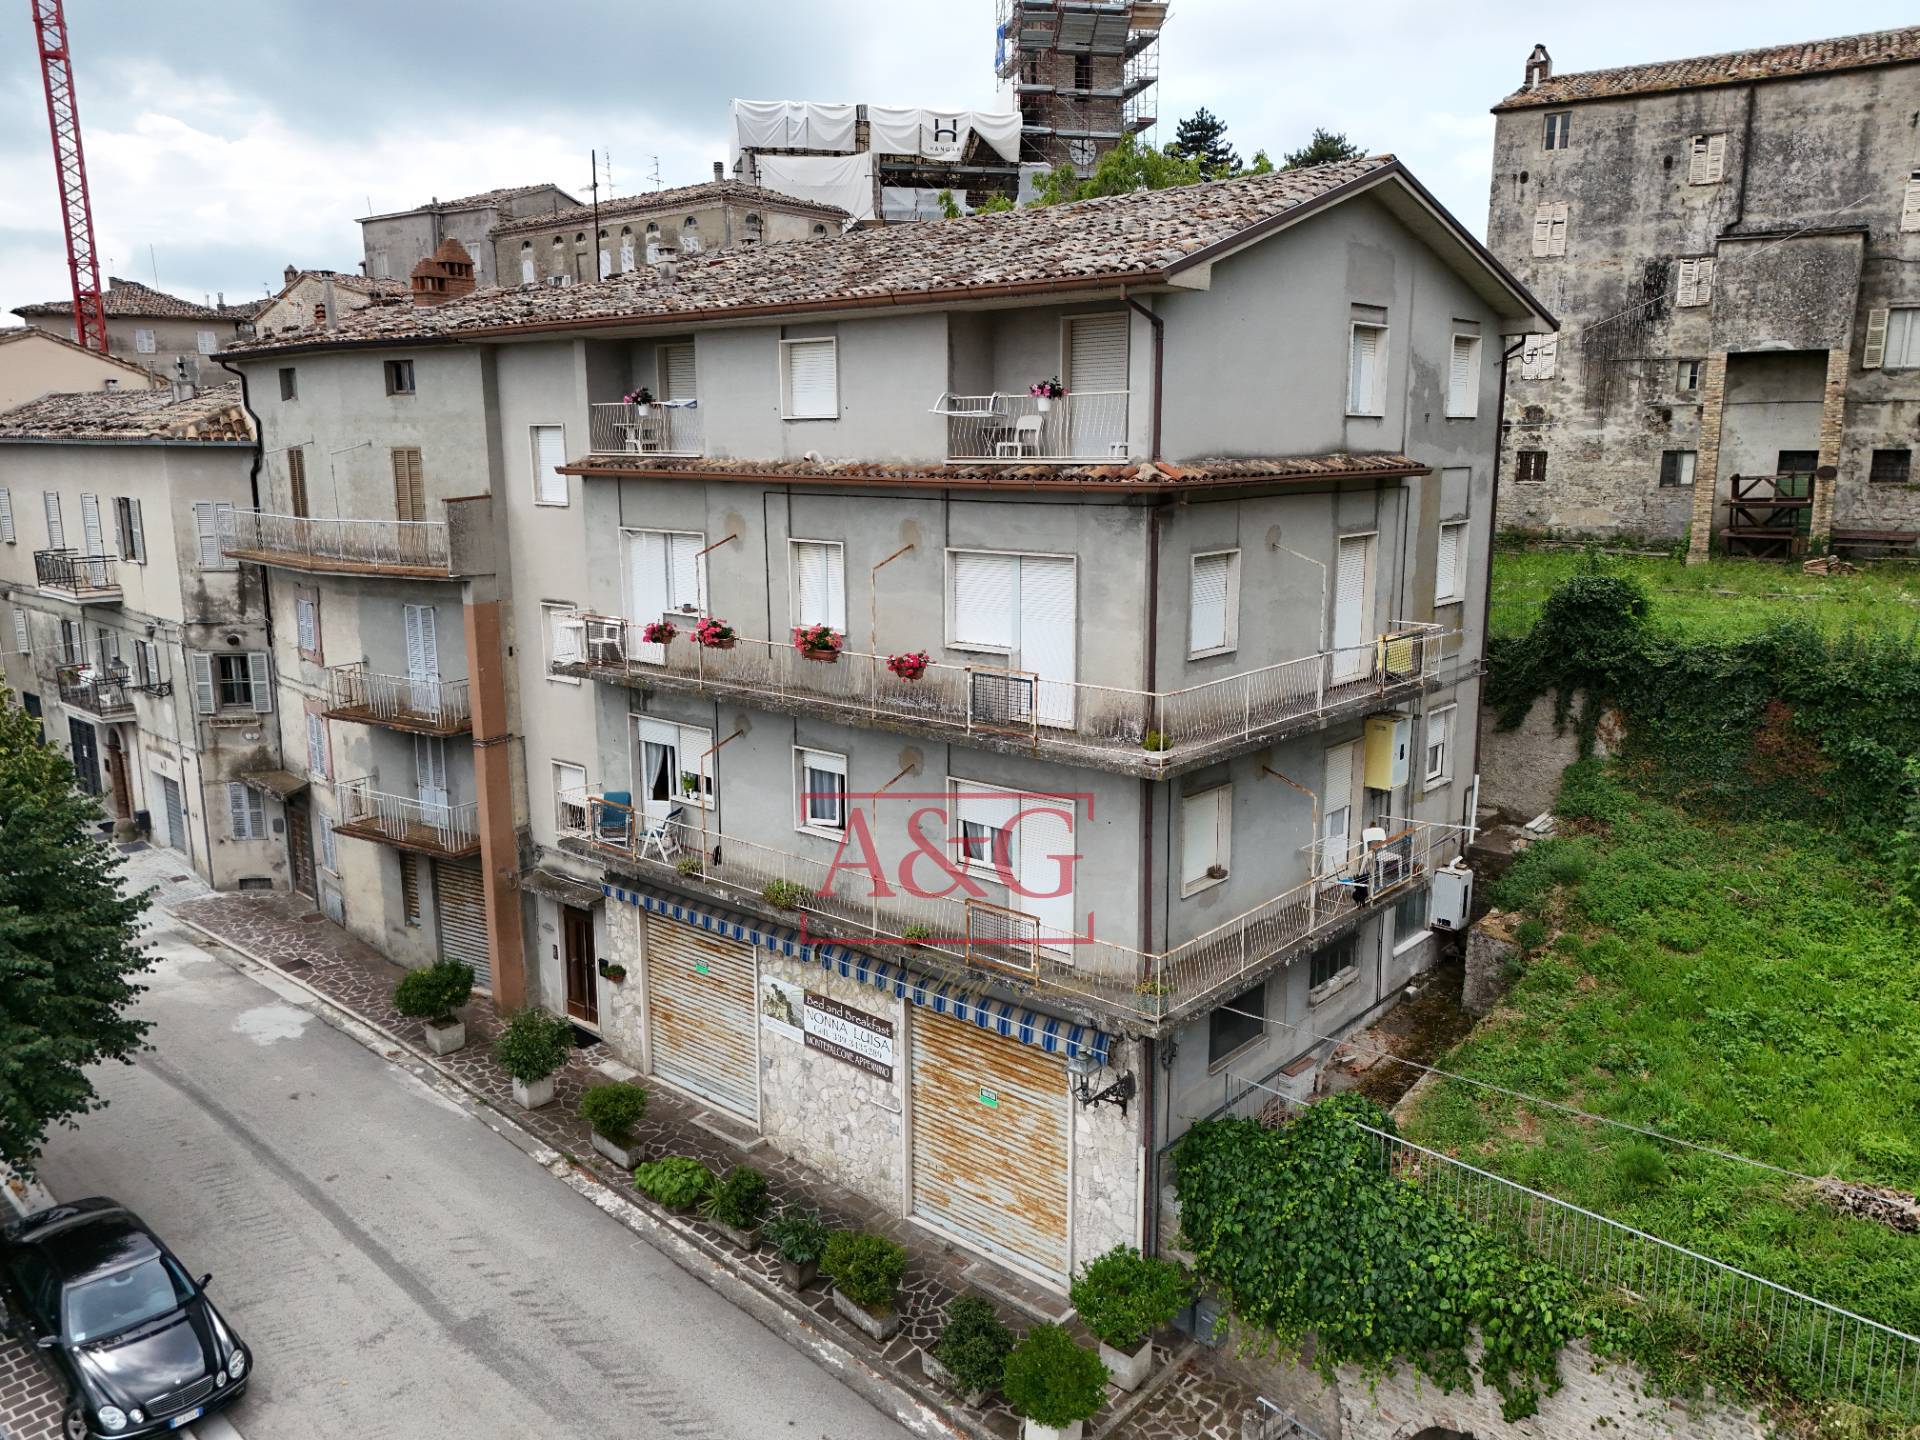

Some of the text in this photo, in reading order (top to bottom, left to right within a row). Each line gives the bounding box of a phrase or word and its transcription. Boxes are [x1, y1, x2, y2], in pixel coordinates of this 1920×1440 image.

[806, 995, 891, 1036] Bed and Breakfast
[807, 1009, 848, 1035] NONNA
[854, 1025, 891, 1053] LUISA
[806, 1035, 890, 1078] MONTEFALCONE APPENNINO
